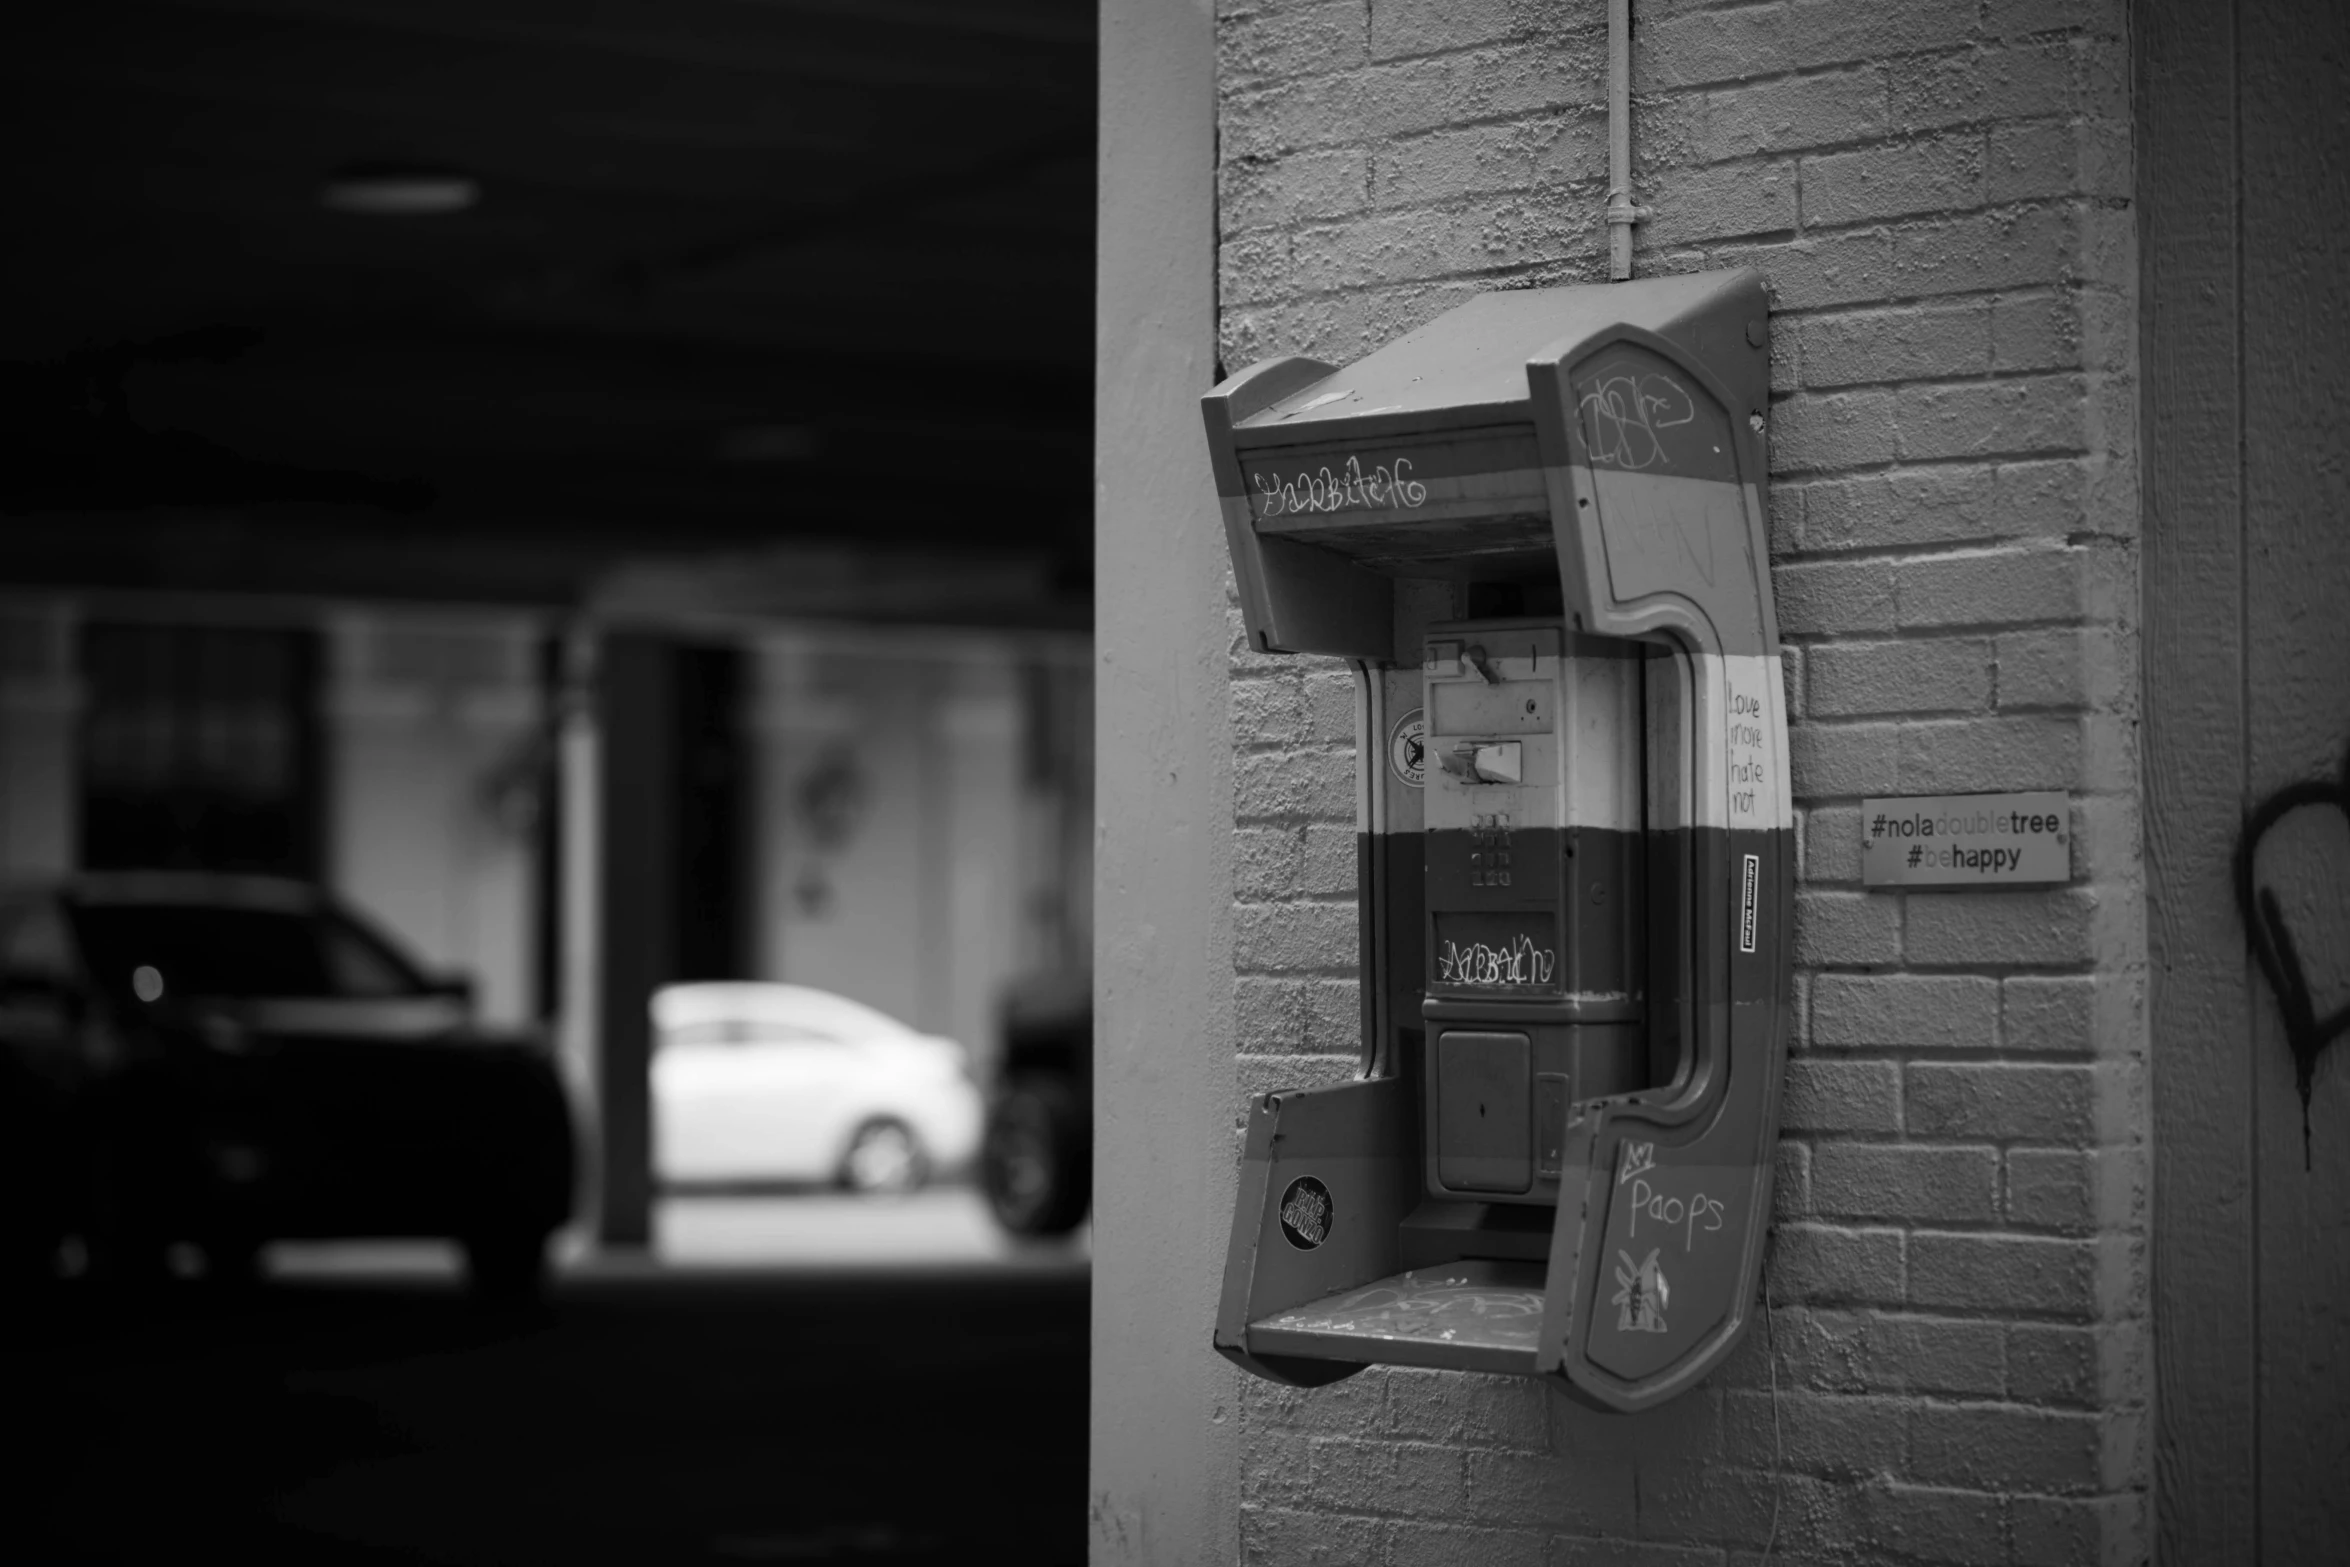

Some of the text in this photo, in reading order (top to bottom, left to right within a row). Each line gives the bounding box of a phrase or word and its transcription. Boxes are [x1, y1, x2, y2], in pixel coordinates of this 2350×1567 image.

[1728, 679, 1760, 718] Love
[1730, 723, 1763, 749] more
[1730, 748, 1764, 783] hate
[1733, 788, 1756, 816] not
[1871, 810, 2060, 838] #noladoubletree
[1906, 844, 2022, 874] #behappy
[1746, 861, 1754, 907] Adrienne
[1282, 1202, 1325, 1245] GONZO
